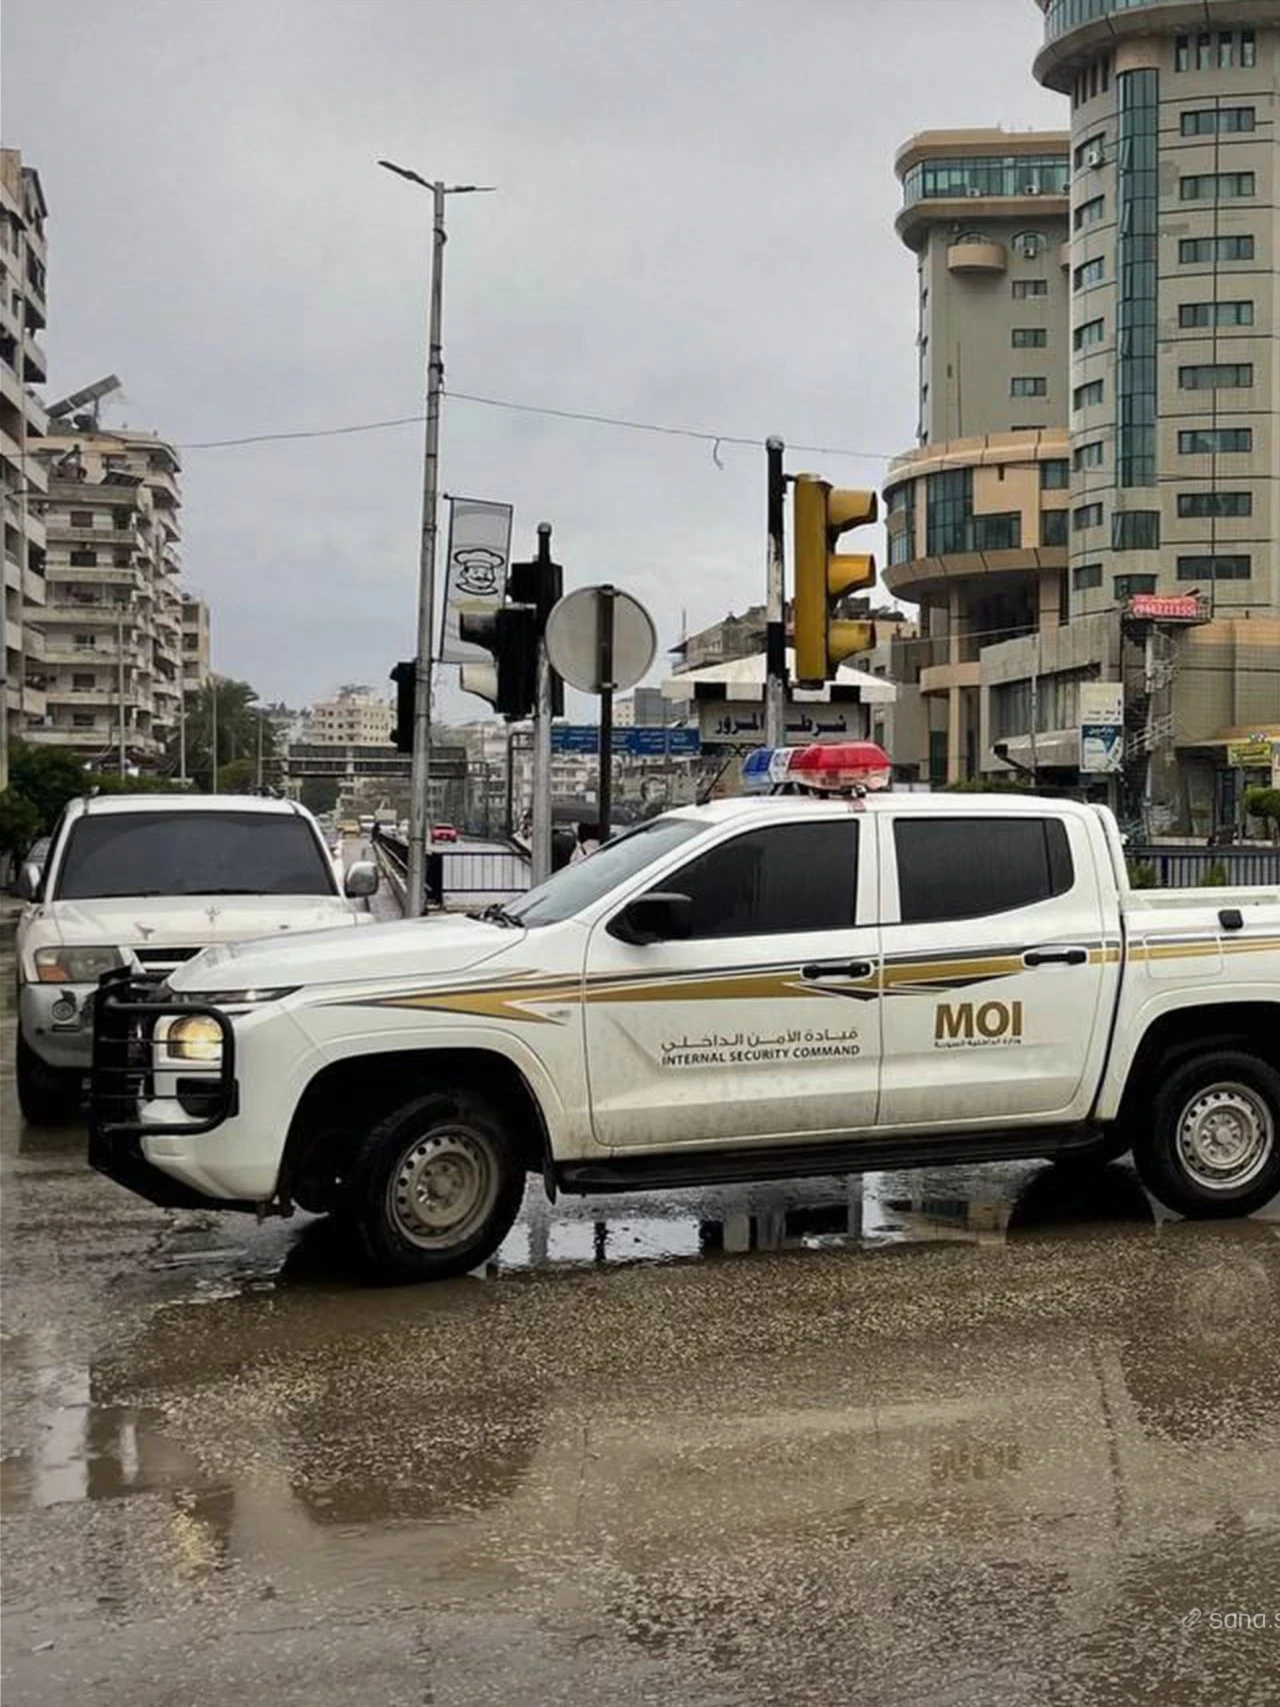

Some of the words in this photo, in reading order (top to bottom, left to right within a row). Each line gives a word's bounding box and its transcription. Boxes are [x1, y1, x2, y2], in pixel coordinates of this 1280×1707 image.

[715, 712, 765, 736] المرور
[785, 714, 847, 737] شرط
[935, 1001, 1022, 1039] MOI
[661, 1033, 744, 1053] الداخلي
[748, 1029, 801, 1048] الأمن
[805, 1026, 858, 1043] قيادة
[661, 1051, 725, 1067] INTERNAL
[729, 1048, 790, 1063] SECURITY
[793, 1044, 860, 1059] COMMAND
